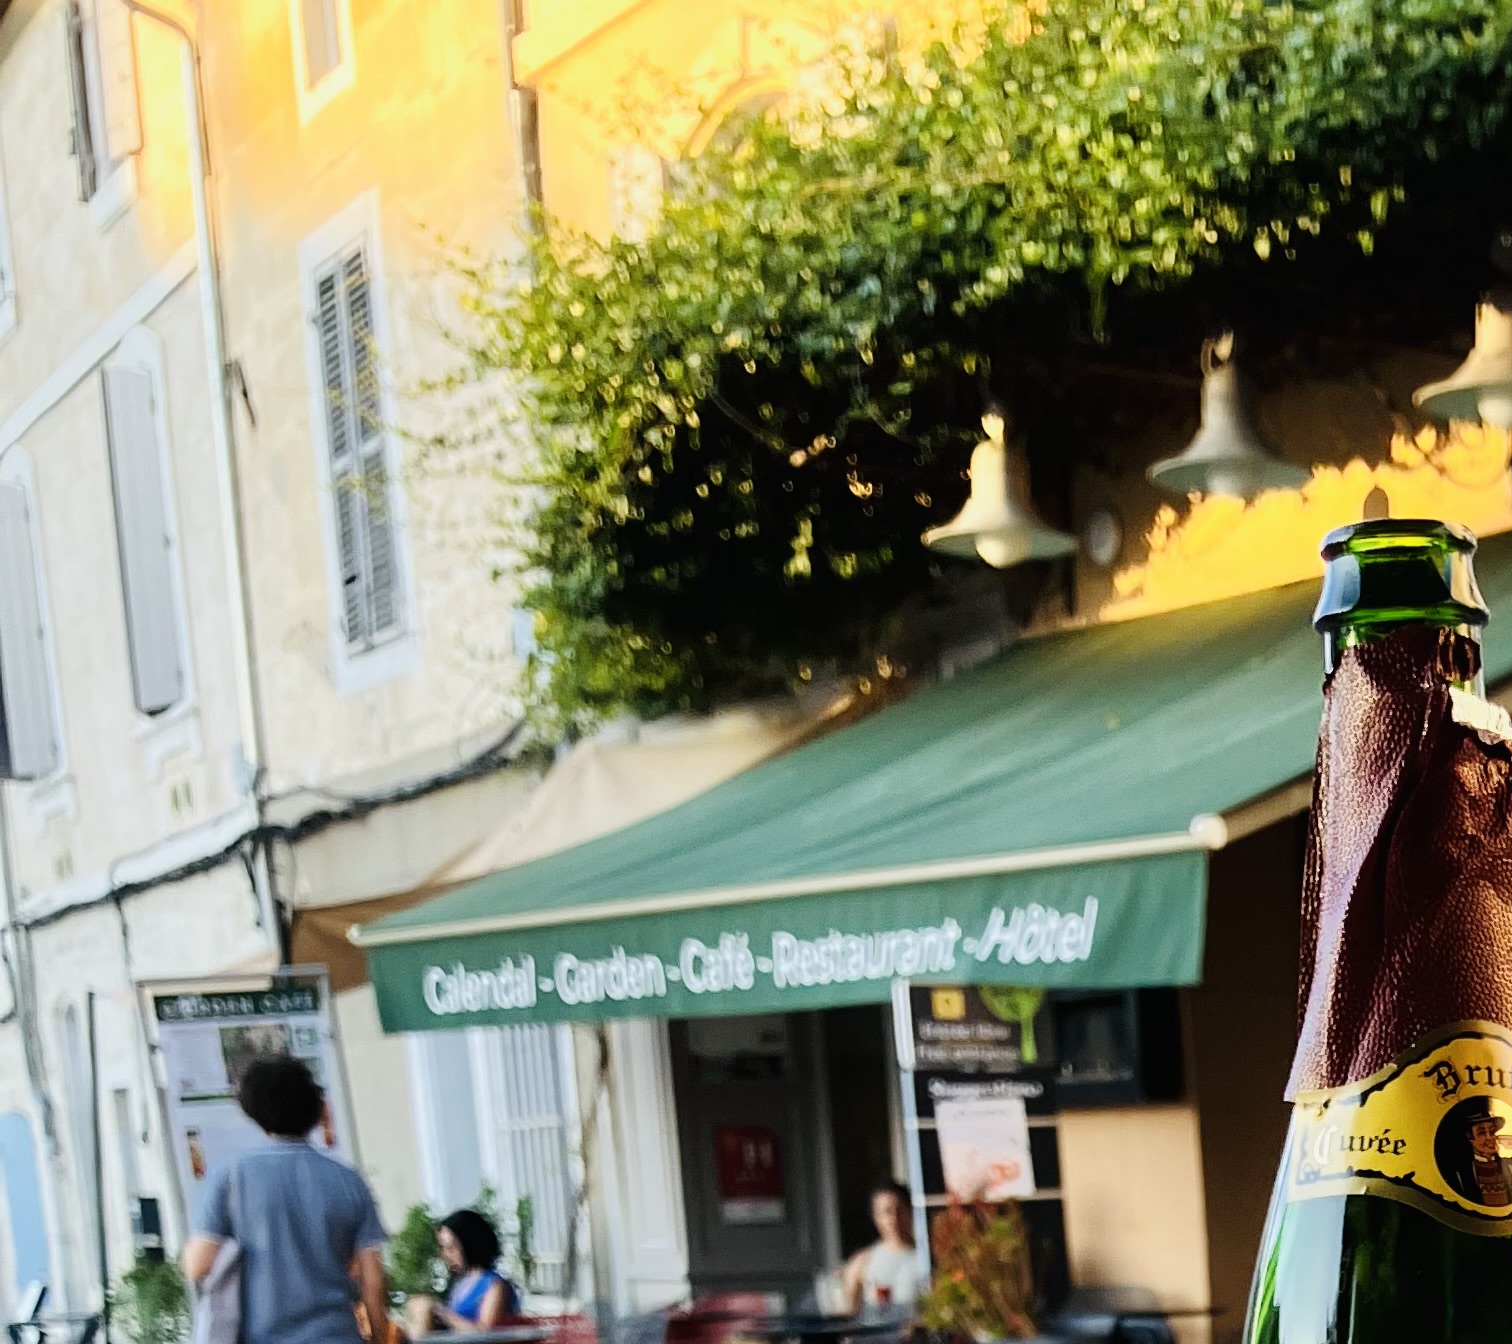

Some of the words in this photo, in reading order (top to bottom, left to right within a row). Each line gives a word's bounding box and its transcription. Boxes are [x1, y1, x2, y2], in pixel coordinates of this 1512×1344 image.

[553, 946, 668, 1005] Garden
[679, 930, 755, 993] Café
[772, 917, 962, 988] Restaurant
[974, 895, 1099, 964] Hôtel
[1314, 1124, 1408, 1166] Cuvée
